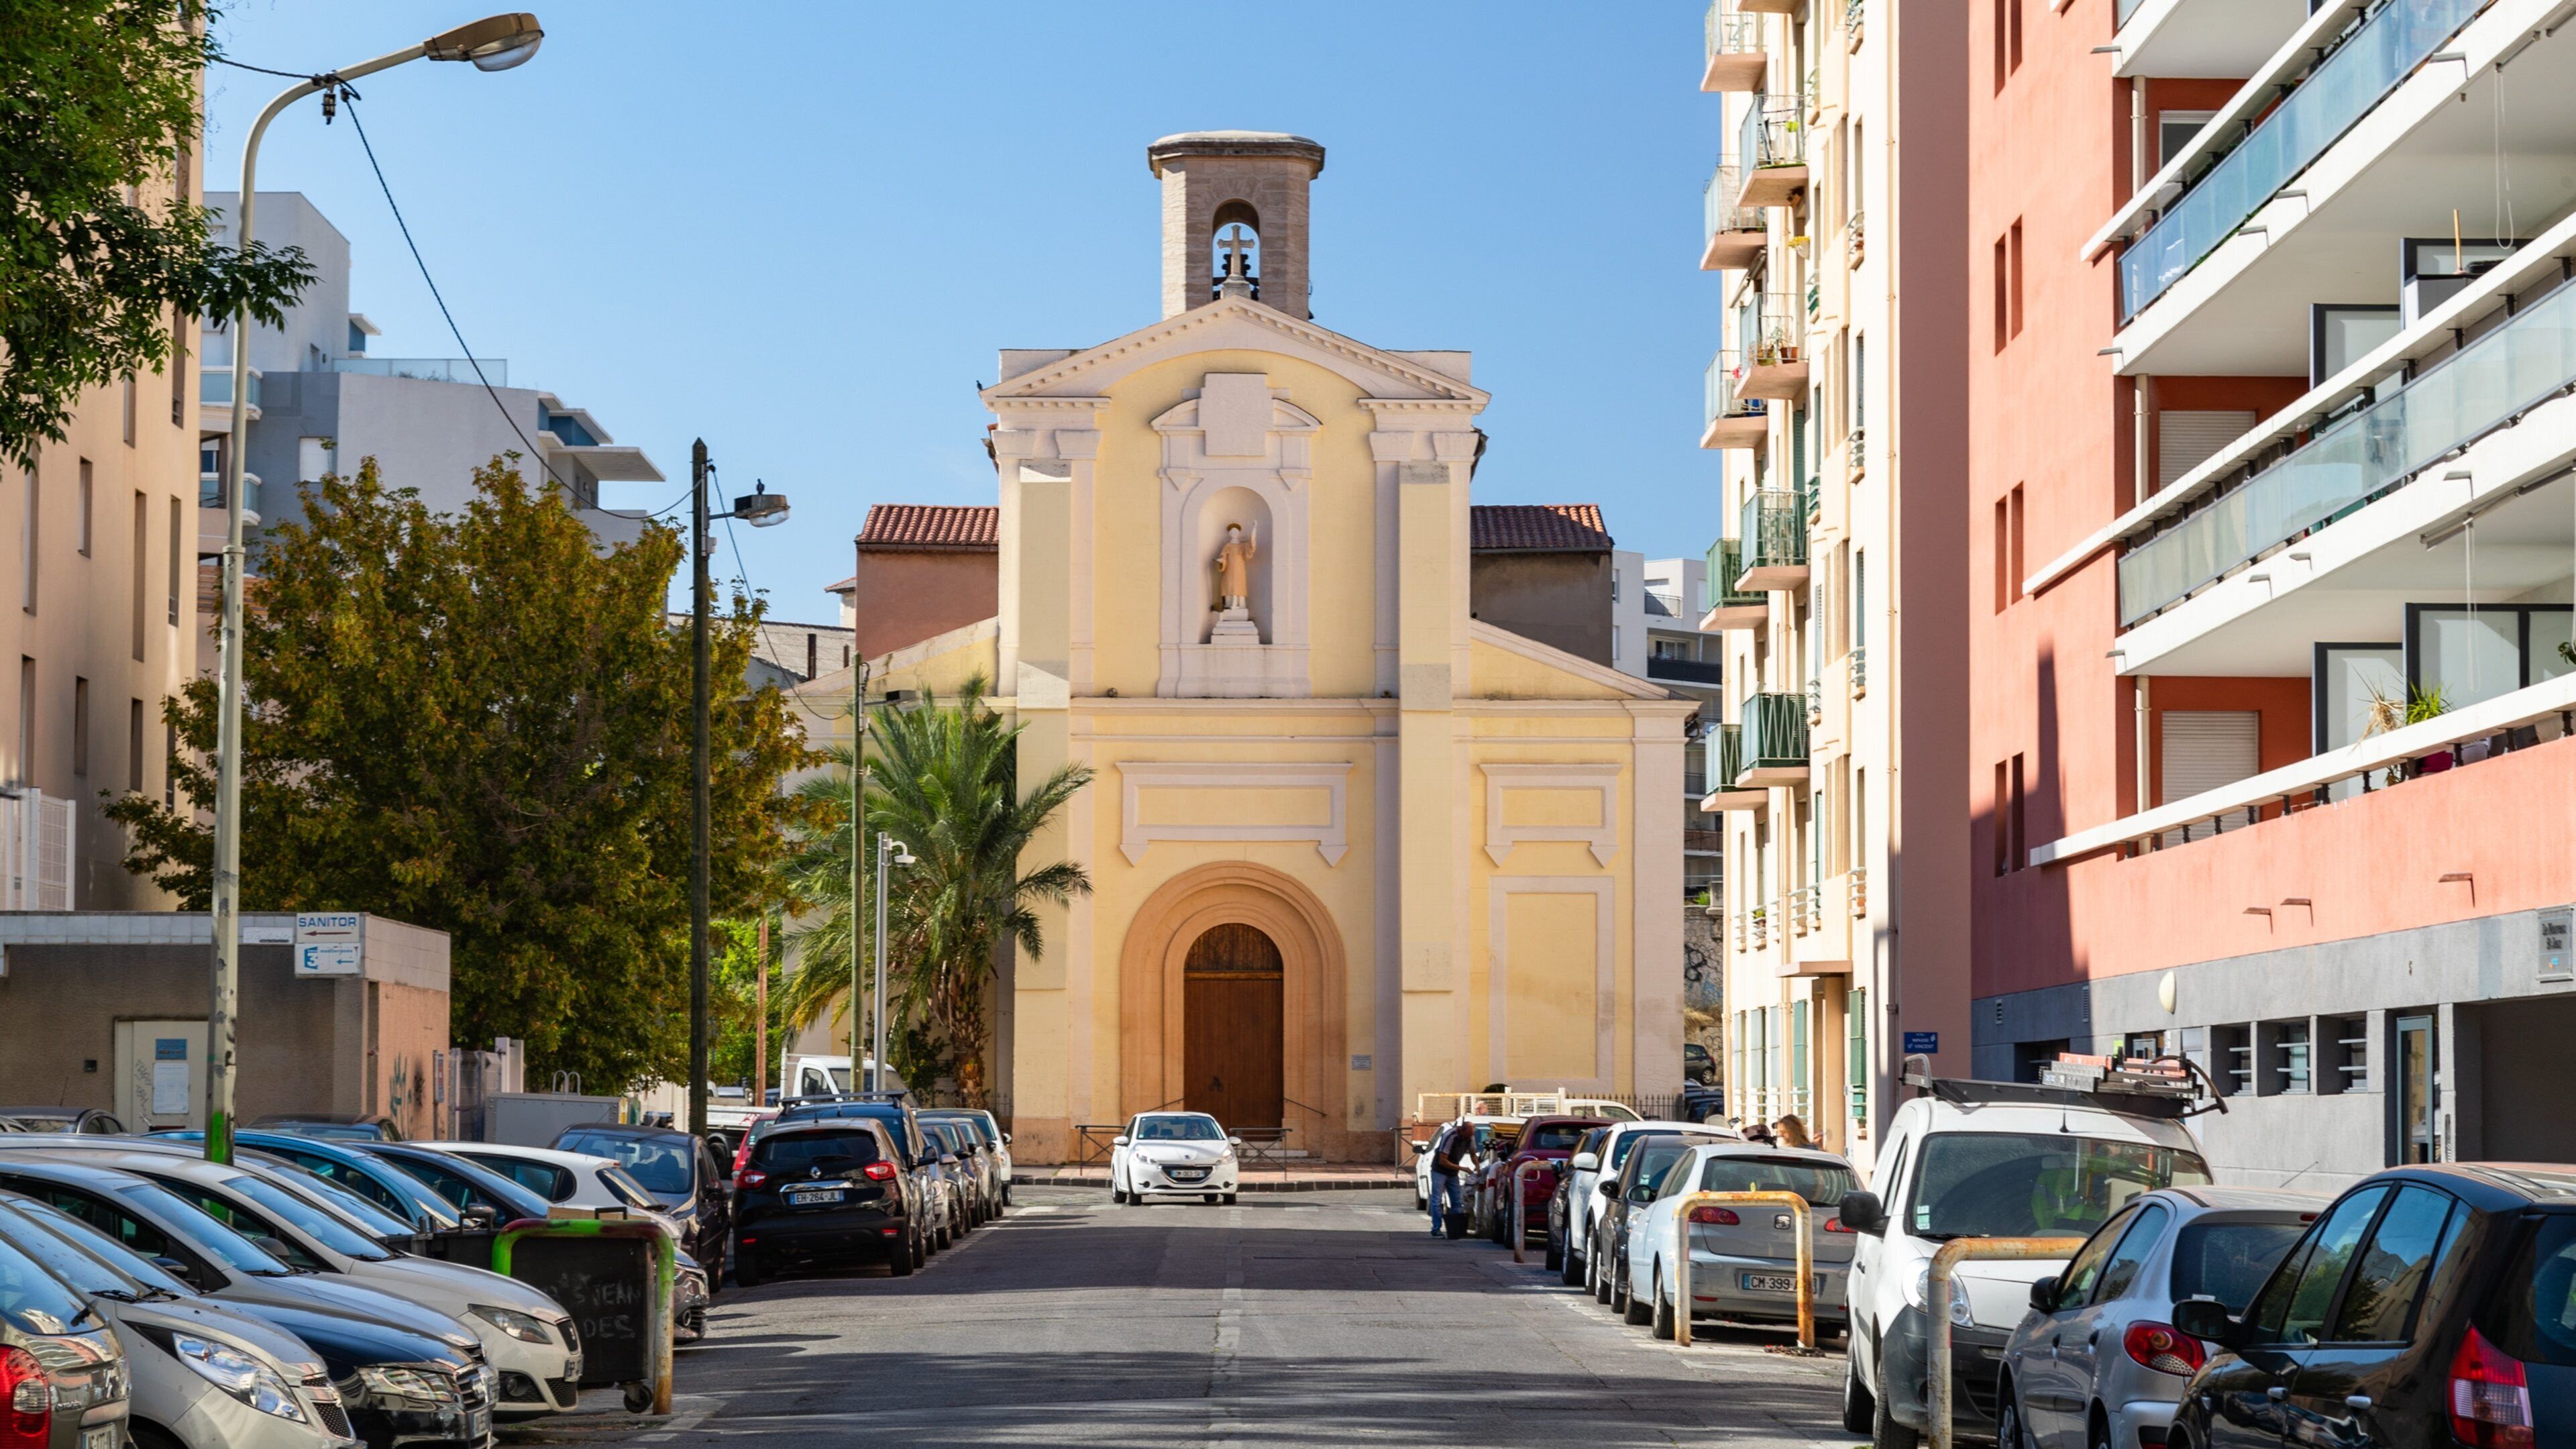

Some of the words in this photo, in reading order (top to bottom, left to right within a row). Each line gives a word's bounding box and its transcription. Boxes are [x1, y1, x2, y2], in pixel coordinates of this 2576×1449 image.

[299, 917, 357, 927] SANITOR
[796, 1192, 838, 1203] EH-264-JL
[583, 1315, 636, 1338] DES
